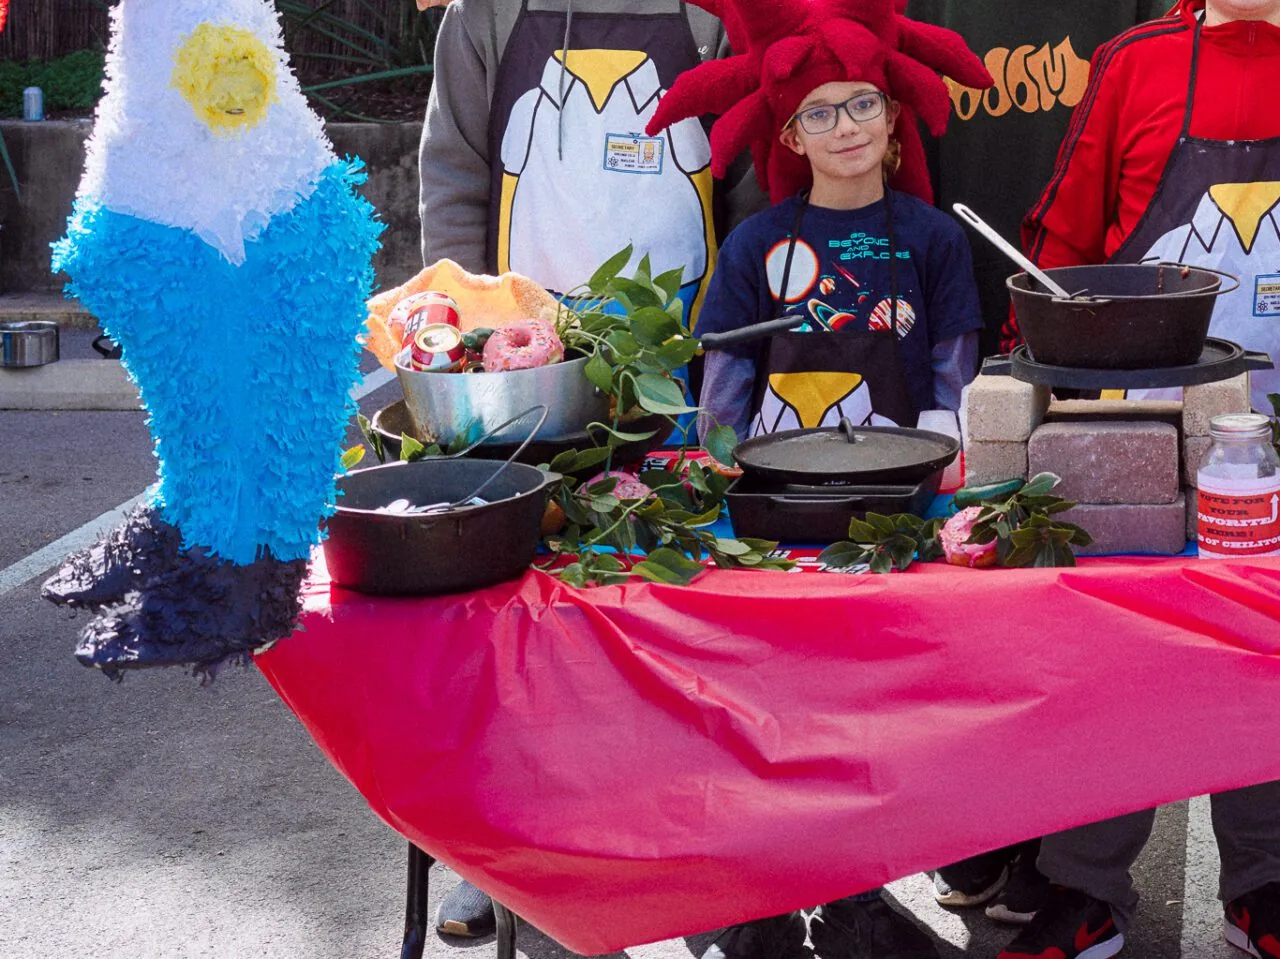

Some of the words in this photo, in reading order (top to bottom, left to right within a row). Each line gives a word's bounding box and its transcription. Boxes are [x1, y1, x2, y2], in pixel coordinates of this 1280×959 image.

[1200, 493, 1230, 504] VOTE
[1210, 507, 1249, 515] YOUR
[1198, 512, 1272, 527] FAVORITE
